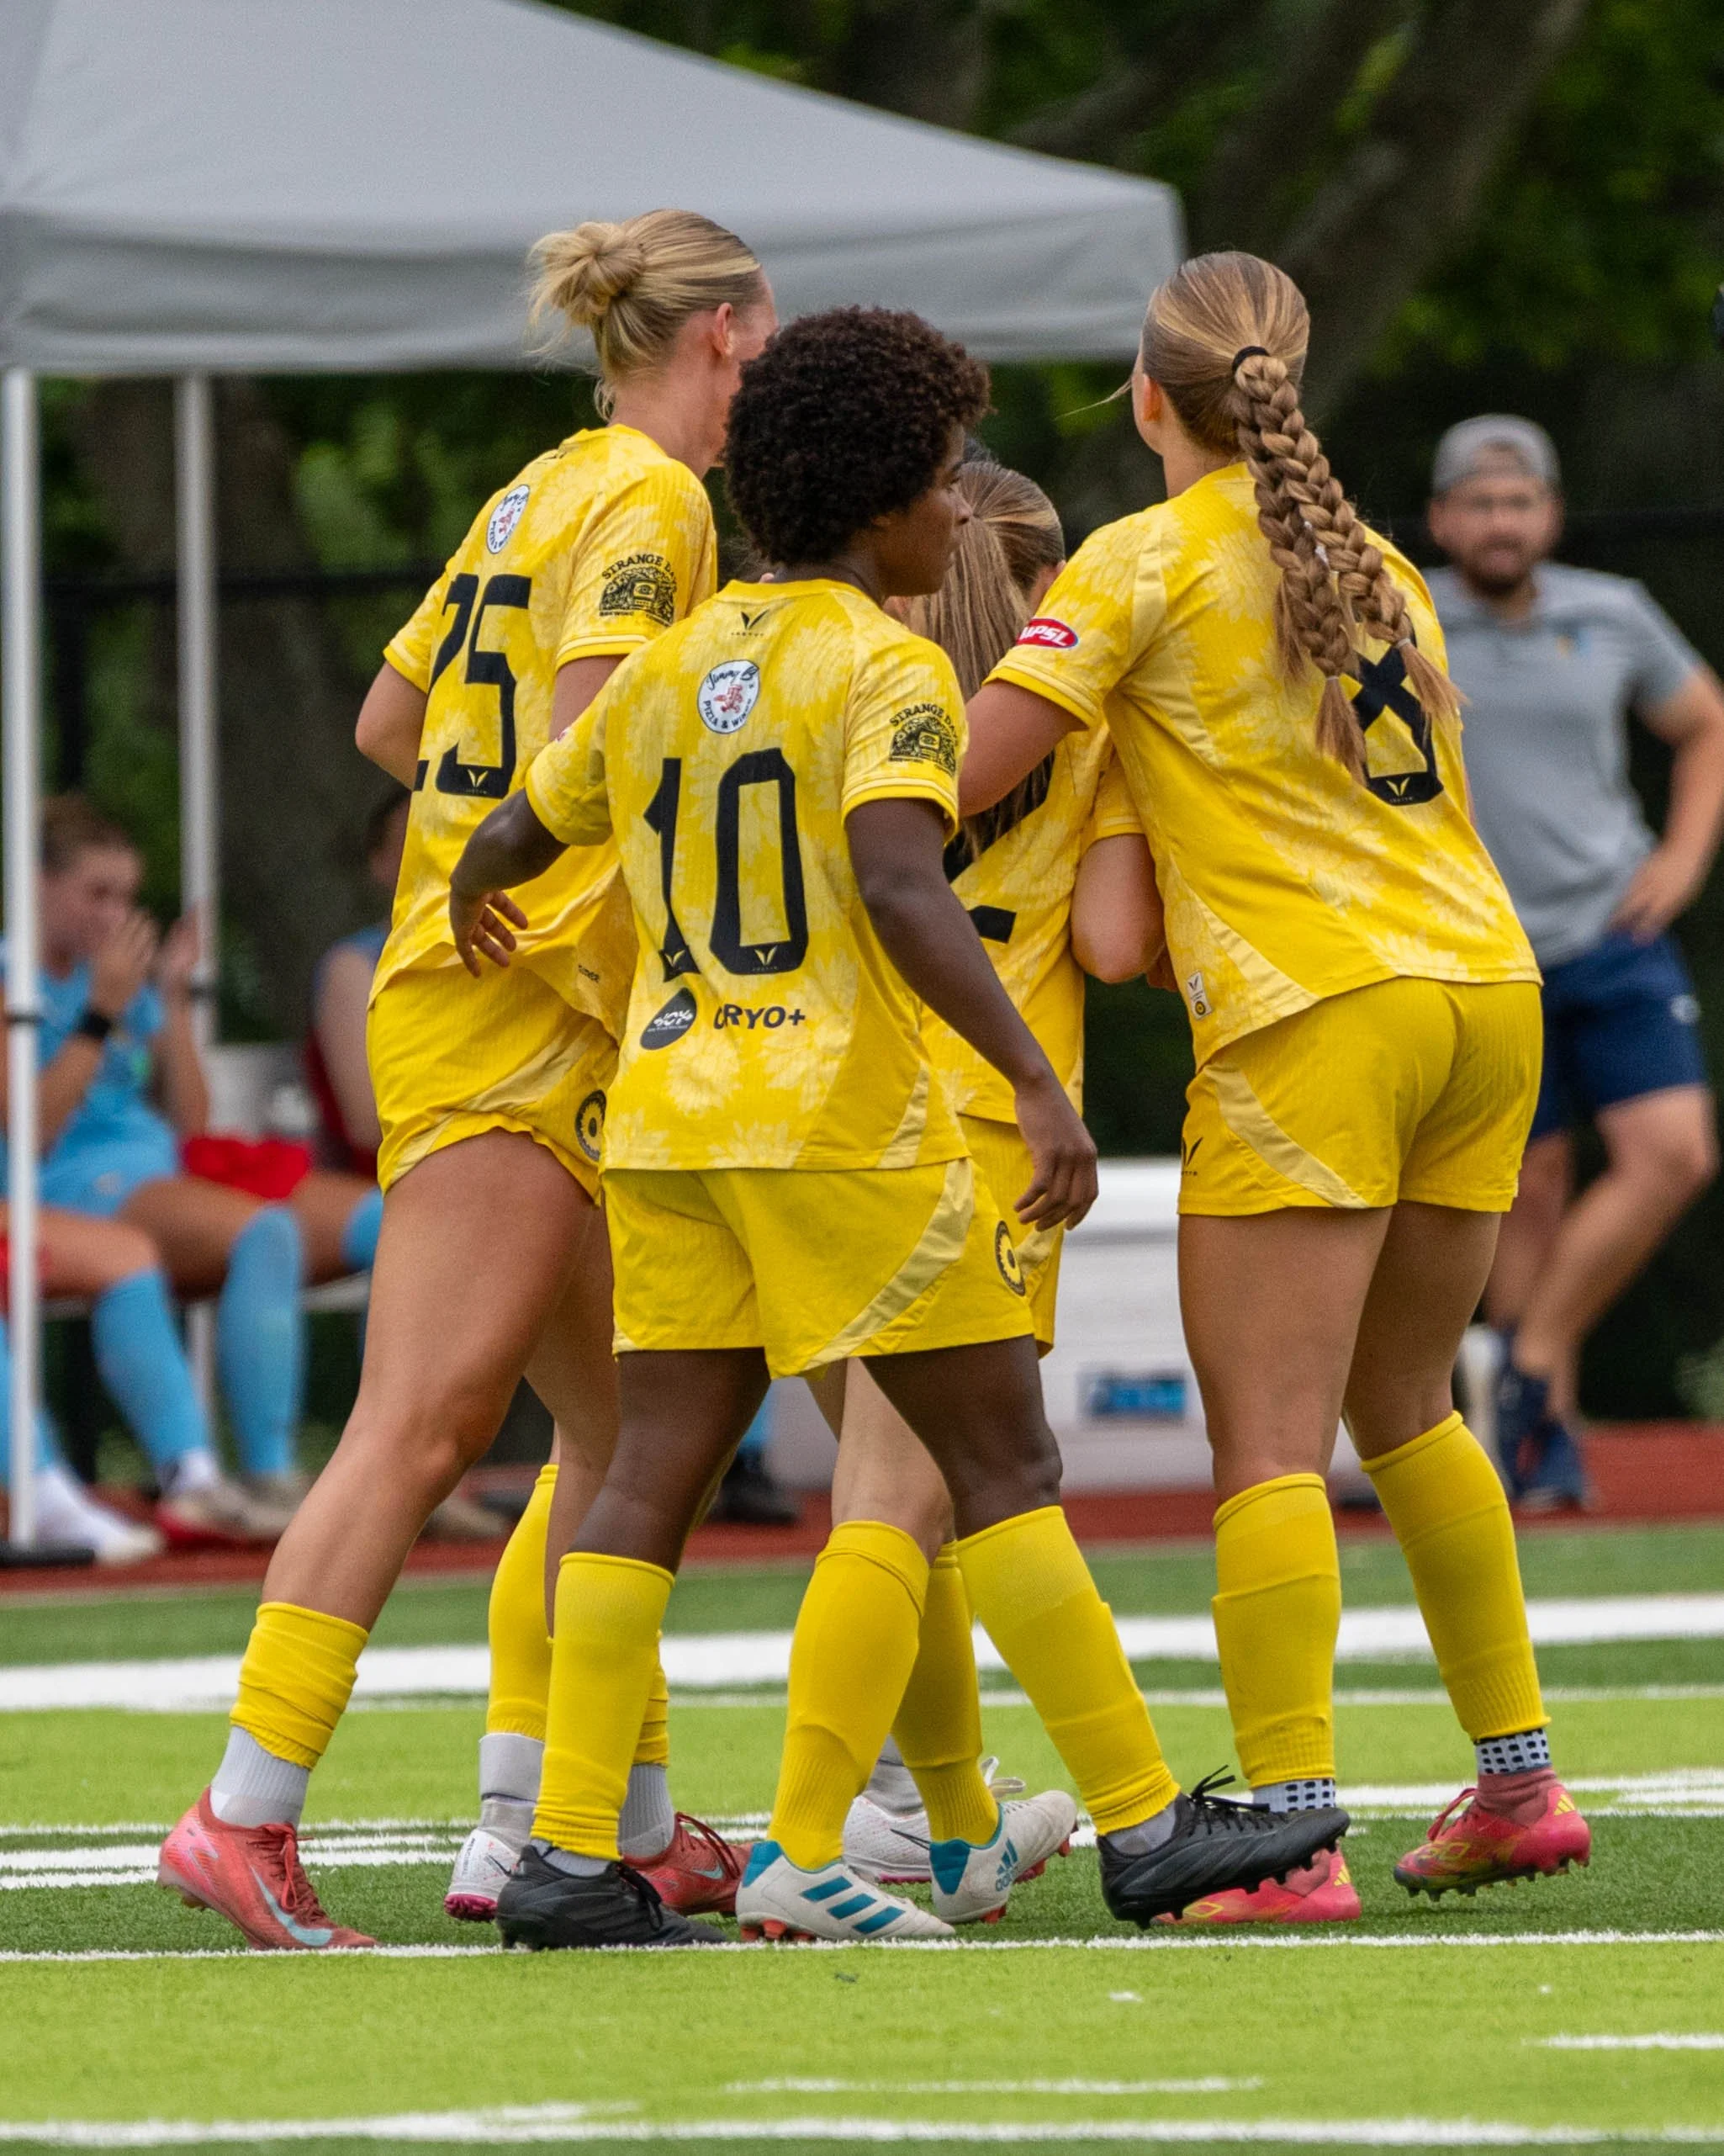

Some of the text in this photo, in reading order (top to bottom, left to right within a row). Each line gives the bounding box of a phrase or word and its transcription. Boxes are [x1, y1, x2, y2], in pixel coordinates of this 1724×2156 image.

[601, 554, 664, 580] STRANGE
[413, 573, 532, 800] 25
[703, 700, 719, 727] PIZZA
[721, 719, 729, 729] &
[889, 702, 944, 727] STRANGE
[643, 747, 808, 983] 10
[713, 1004, 806, 1030] CRYO+
